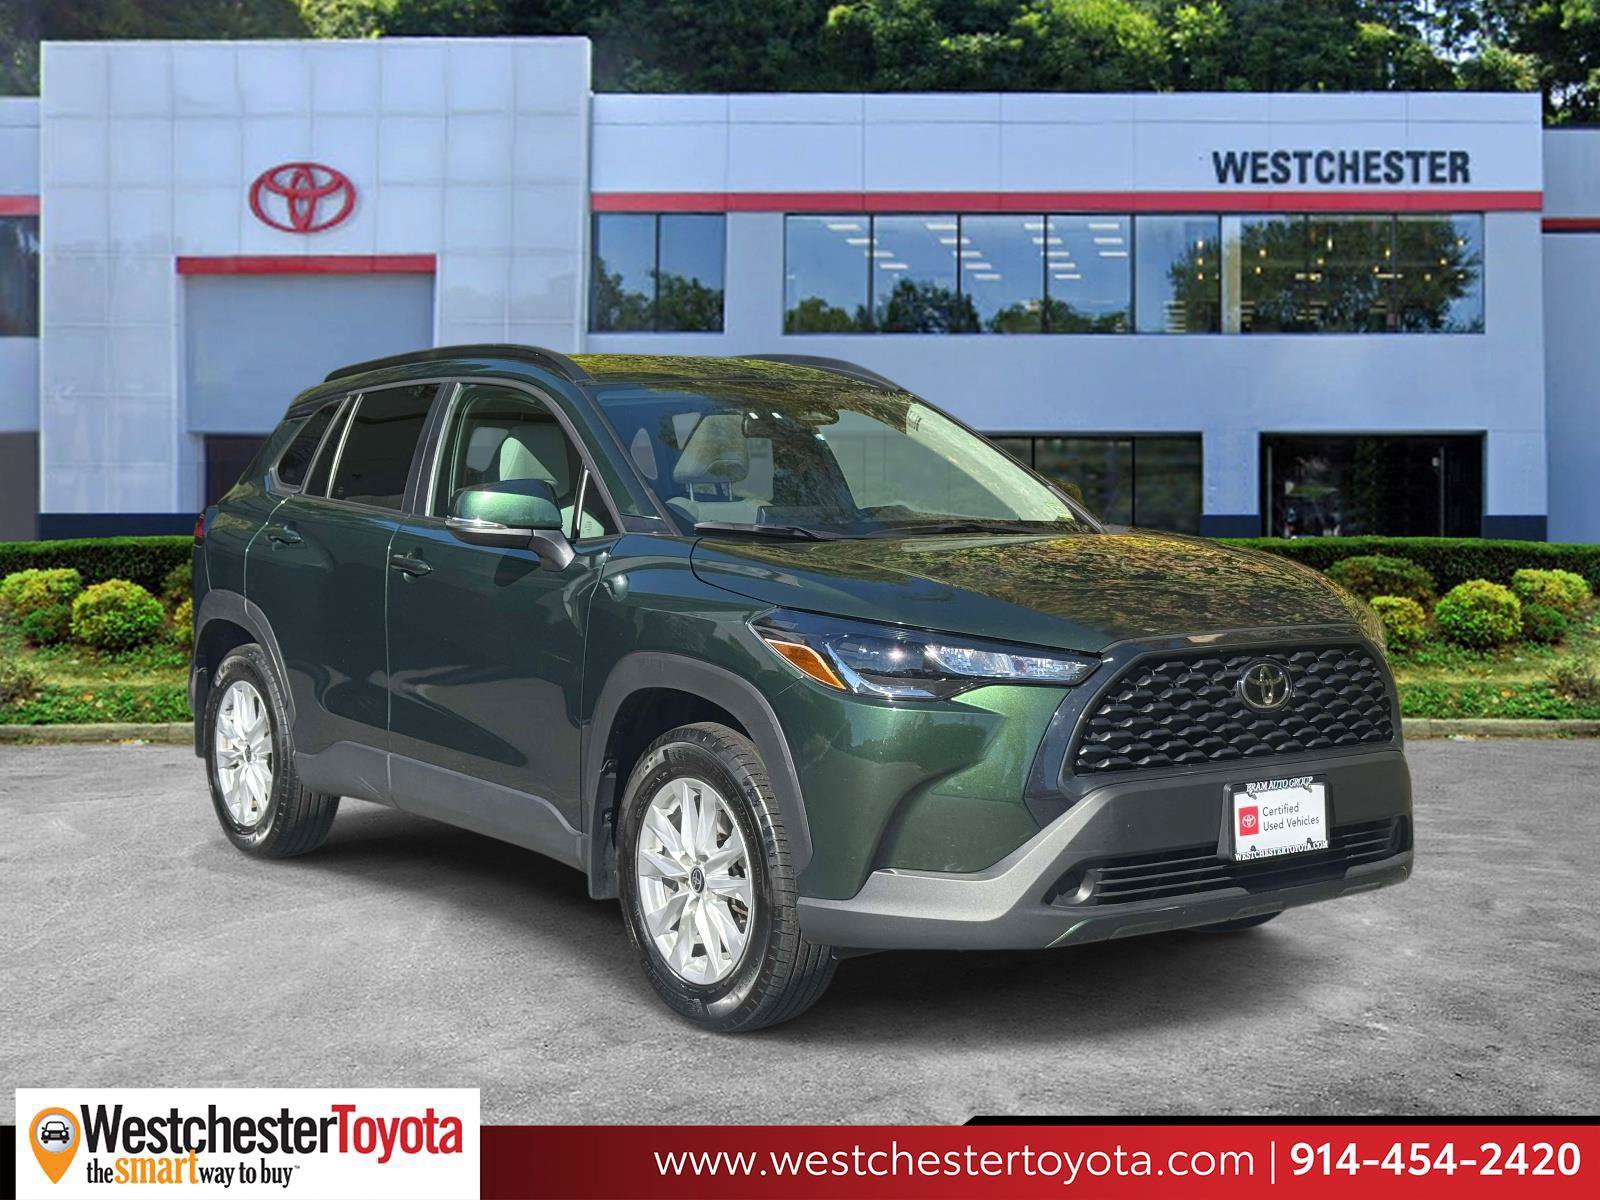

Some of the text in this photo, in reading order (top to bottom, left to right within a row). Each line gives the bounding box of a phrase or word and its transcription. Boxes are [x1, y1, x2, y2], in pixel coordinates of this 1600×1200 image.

[1212, 150, 1471, 184] WESTCHESTER
[1268, 779, 1288, 790] AUTO
[1288, 776, 1313, 788] GROUP
[1262, 803, 1300, 817] Certified
[1263, 815, 1320, 831] Used Vehicles
[1235, 841, 1328, 861] WESTCHESTERTOYOTA.COM
